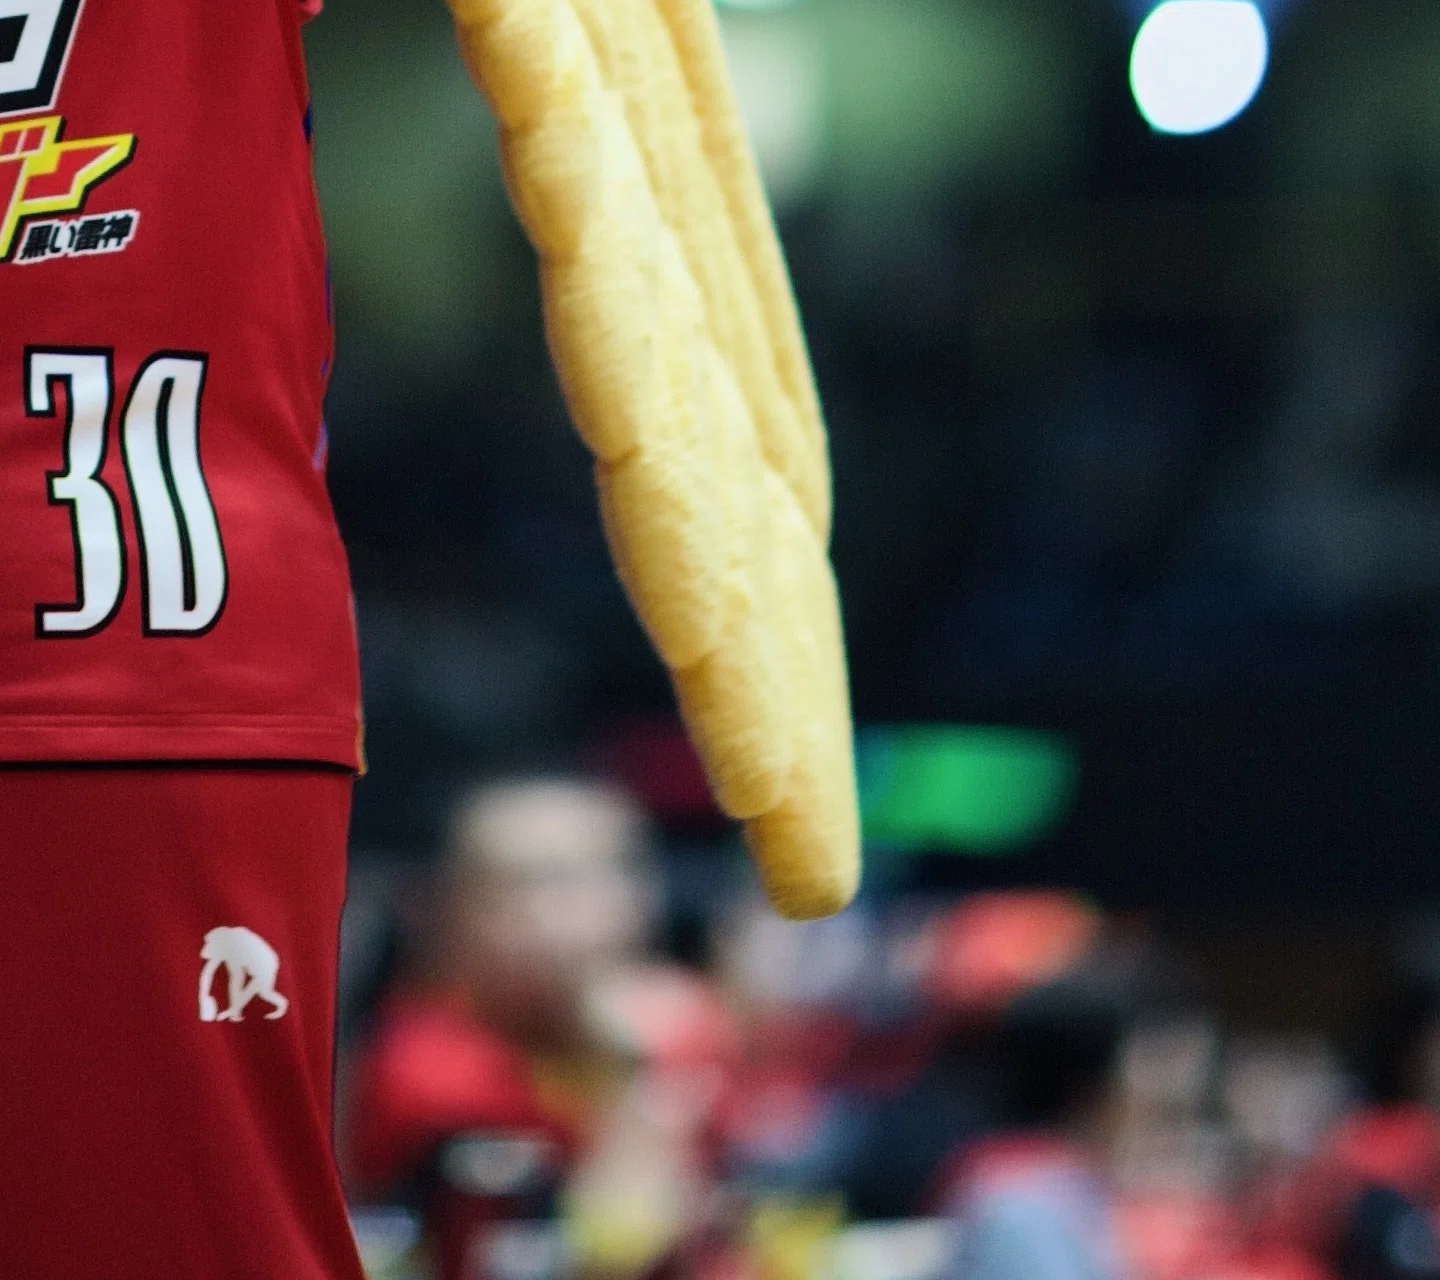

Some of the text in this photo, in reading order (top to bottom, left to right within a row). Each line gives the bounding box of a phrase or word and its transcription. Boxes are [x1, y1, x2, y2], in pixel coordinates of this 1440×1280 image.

[17, 211, 137, 263] 黒い雷神
[24, 345, 229, 638] 30
